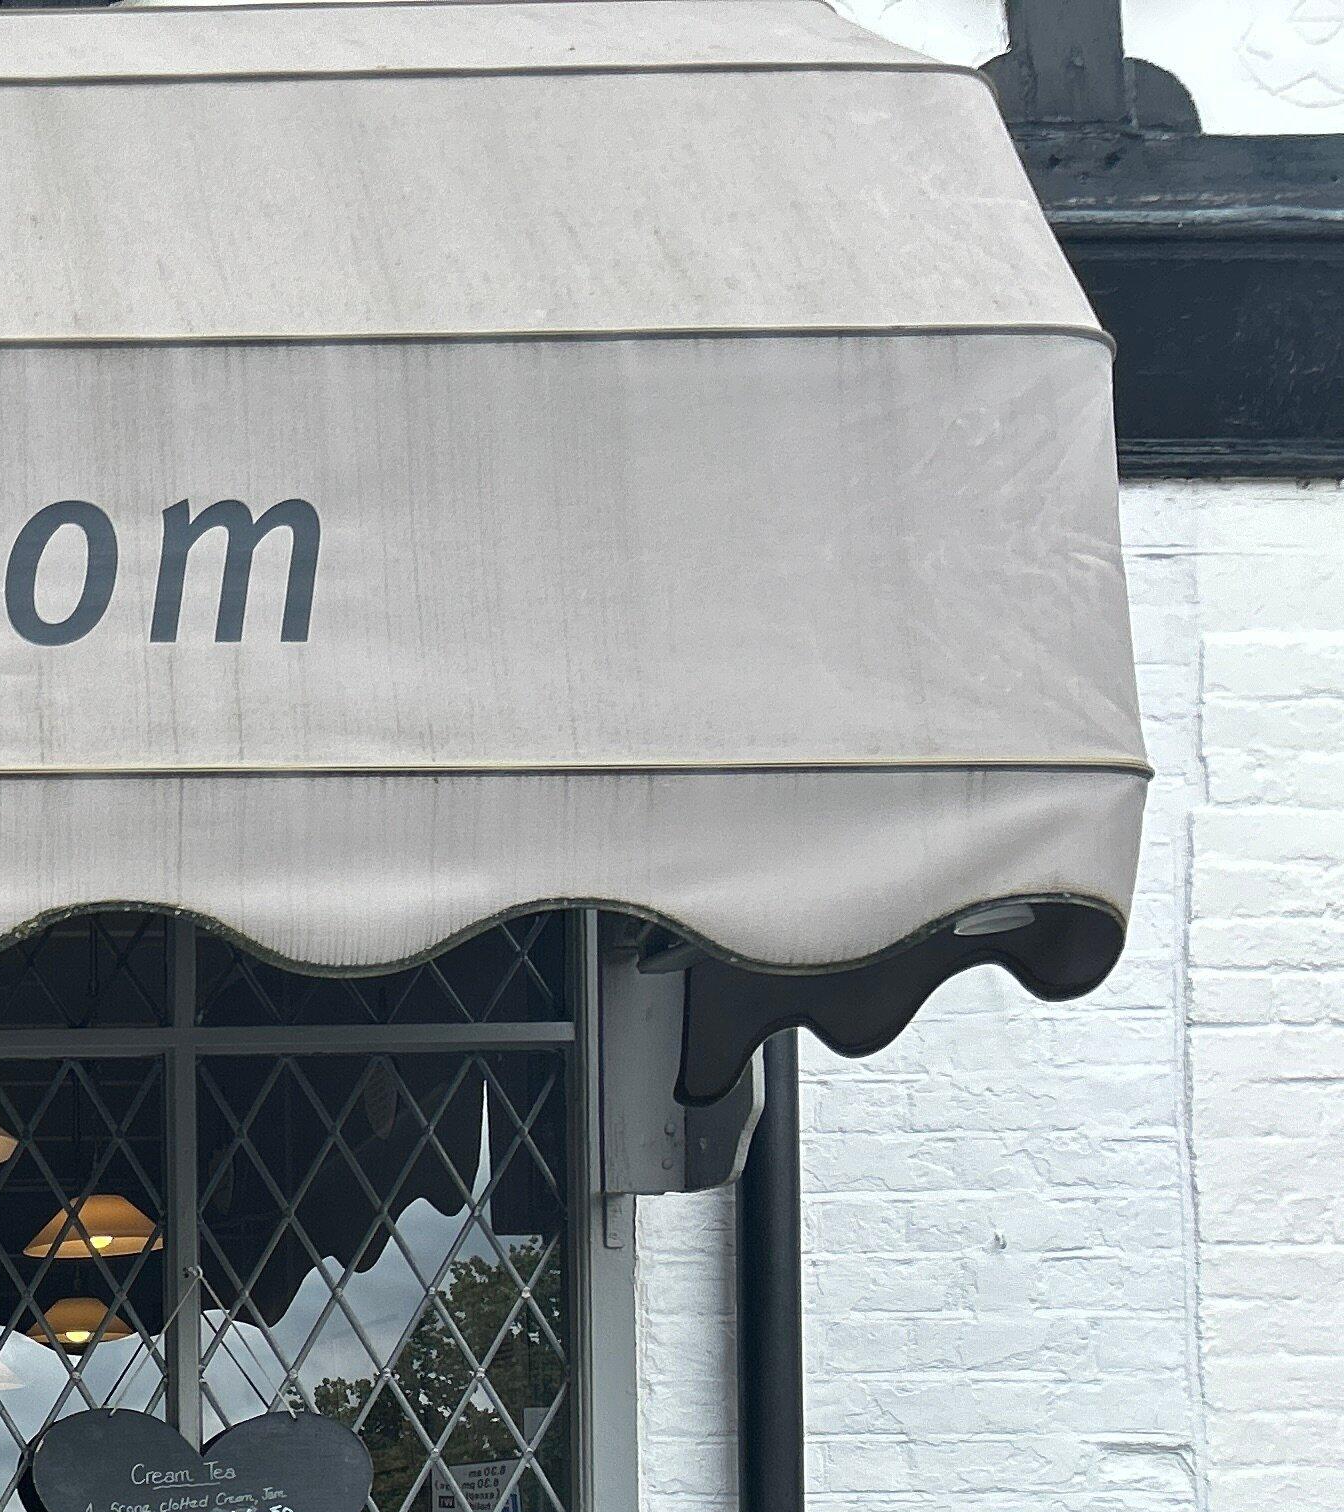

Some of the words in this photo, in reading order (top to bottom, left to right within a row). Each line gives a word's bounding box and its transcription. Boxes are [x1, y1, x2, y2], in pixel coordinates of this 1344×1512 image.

[131, 1463, 195, 1485] Cream
[203, 1461, 236, 1480] Tea
[216, 1492, 258, 1506] Cream,
[262, 1487, 288, 1499] Jam
